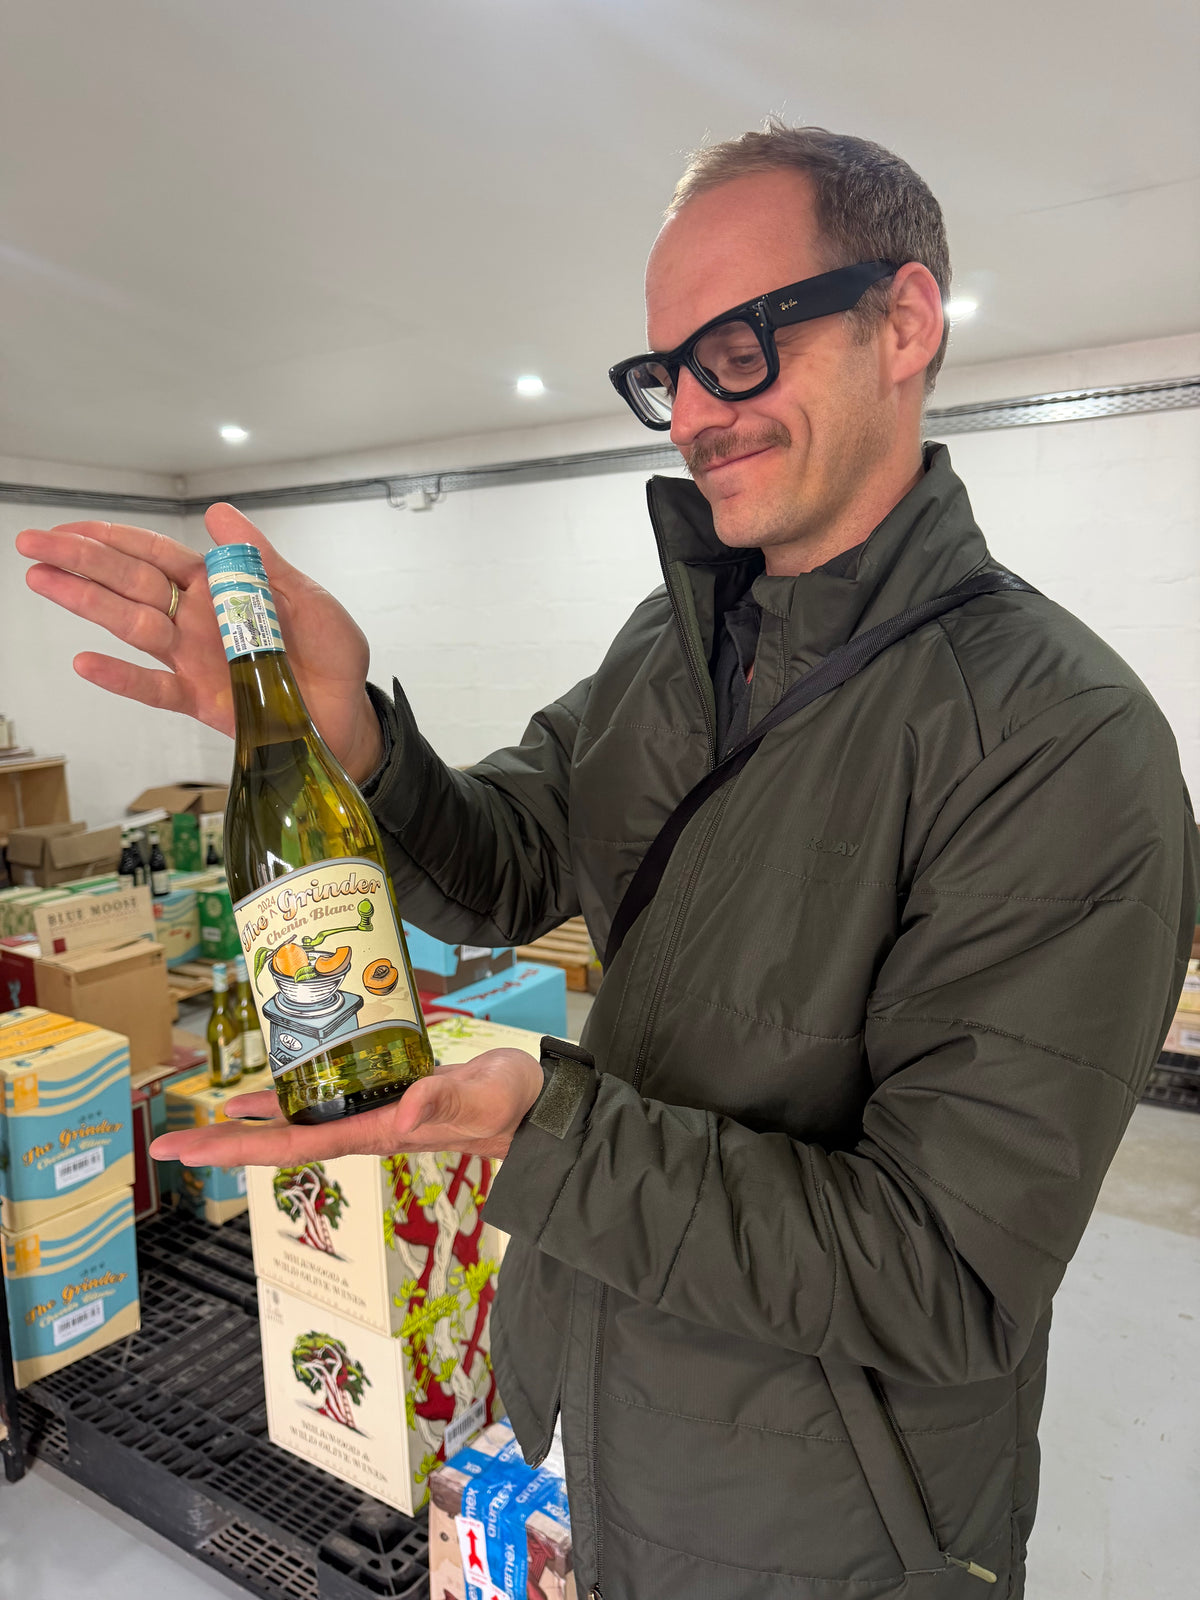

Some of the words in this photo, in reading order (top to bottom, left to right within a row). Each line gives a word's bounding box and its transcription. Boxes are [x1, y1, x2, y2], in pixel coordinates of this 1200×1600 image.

[240, 915, 269, 952] The
[277, 872, 381, 921] Grinder
[257, 895, 277, 914] 2024
[266, 916, 309, 946] Chenin
[310, 902, 356, 921] Blanc
[22, 1142, 54, 1168] The
[59, 1119, 124, 1150] Grinder
[24, 1299, 57, 1327] The
[61, 1270, 128, 1305] Grinder
[486, 1481, 518, 1538] aramex
